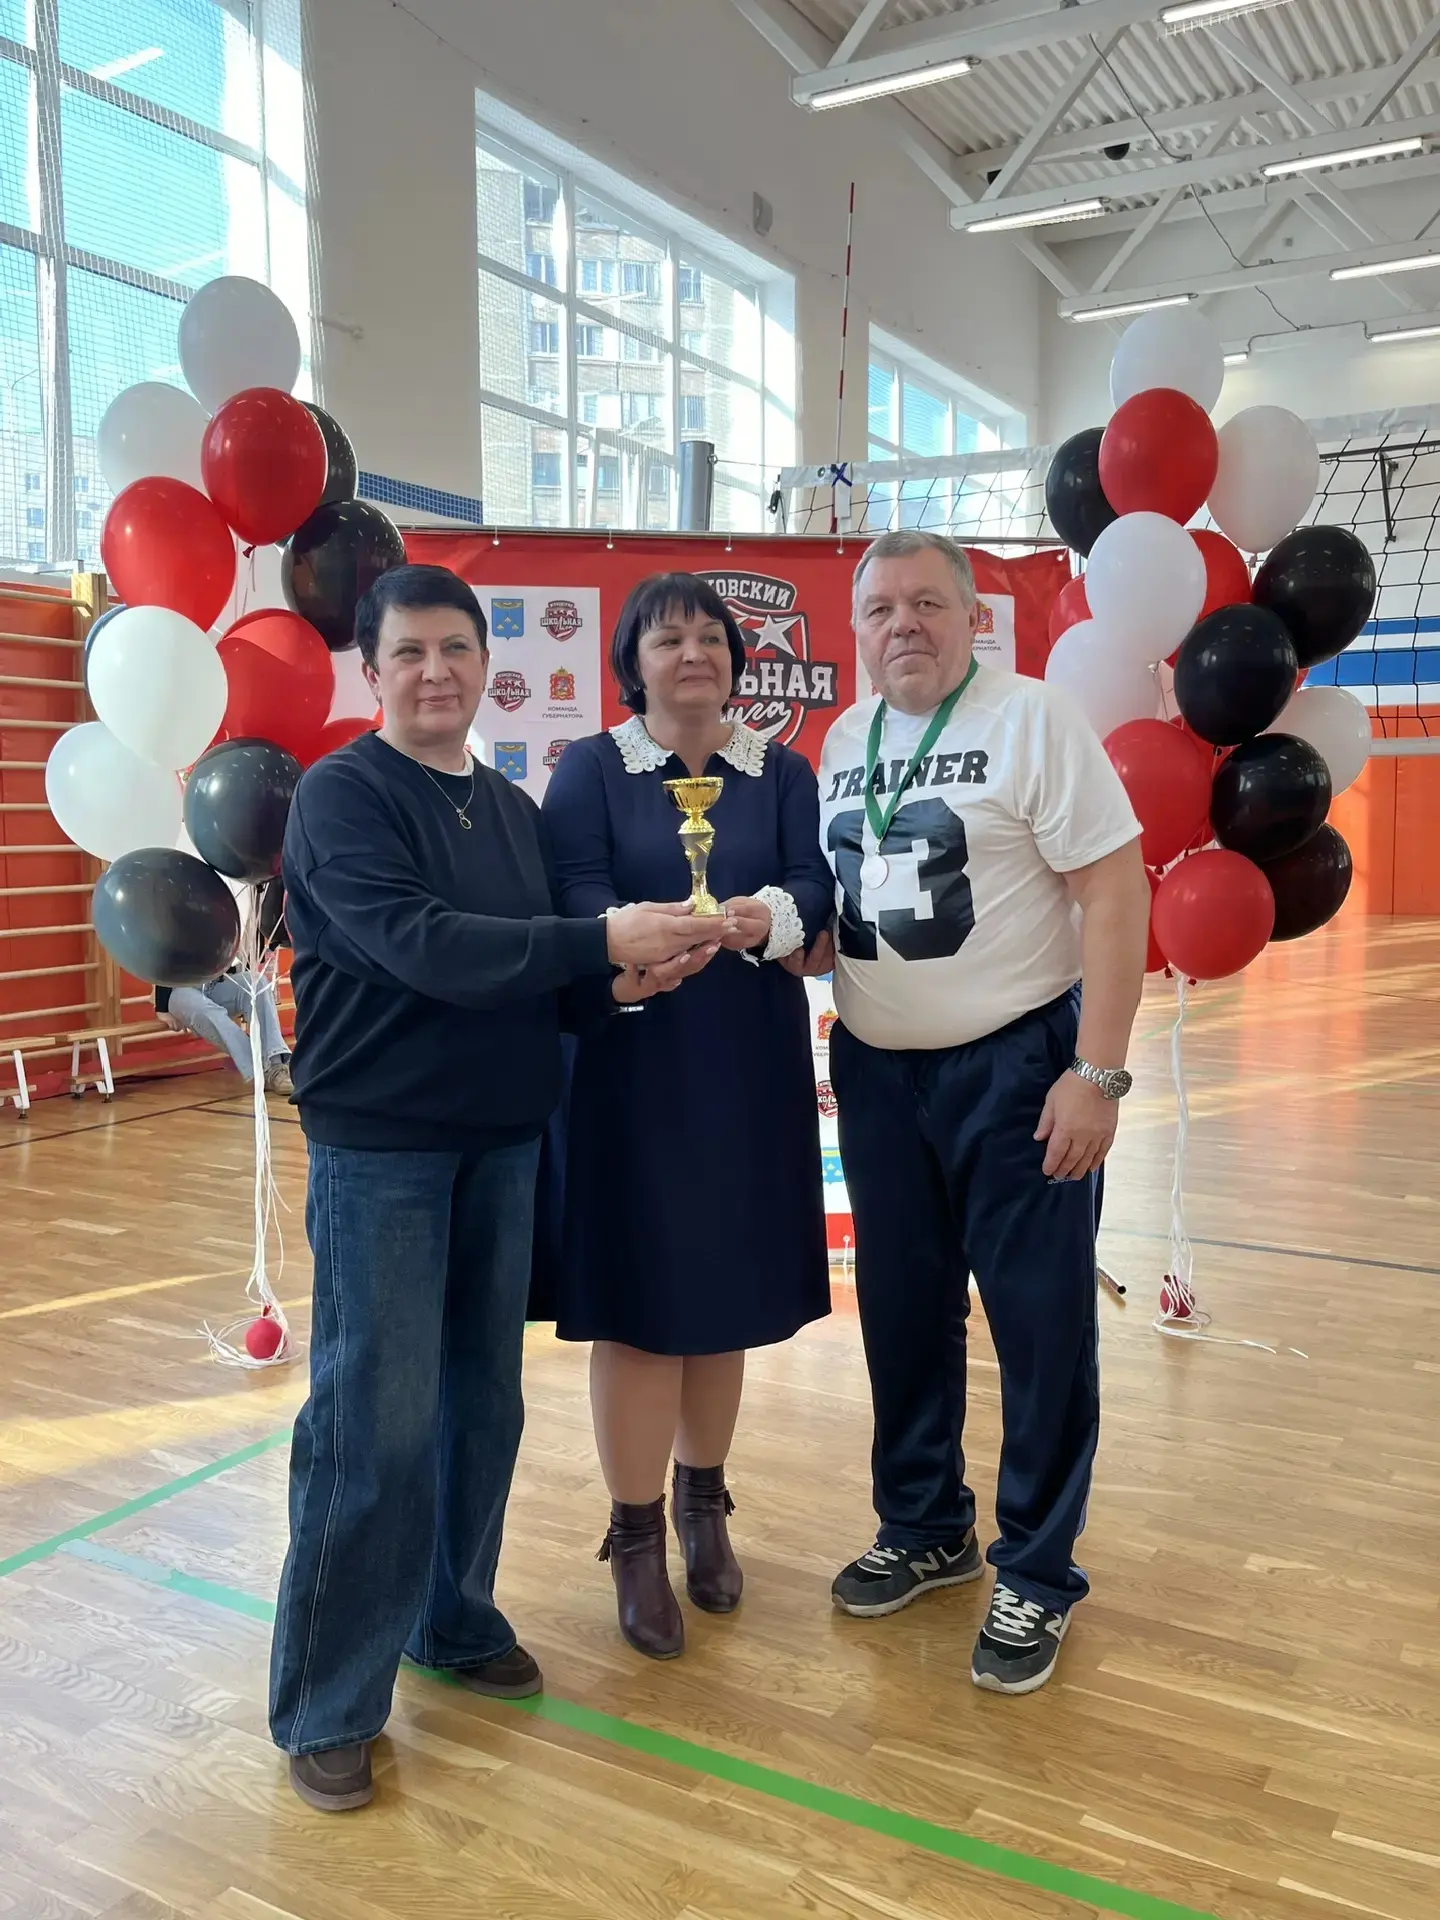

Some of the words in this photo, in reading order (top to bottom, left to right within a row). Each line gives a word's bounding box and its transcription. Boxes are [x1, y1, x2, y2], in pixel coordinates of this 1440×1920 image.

[739, 661, 833, 701] ЬНАЯ
[826, 750, 989, 802] TRAINER
[827, 797, 976, 961] 13
